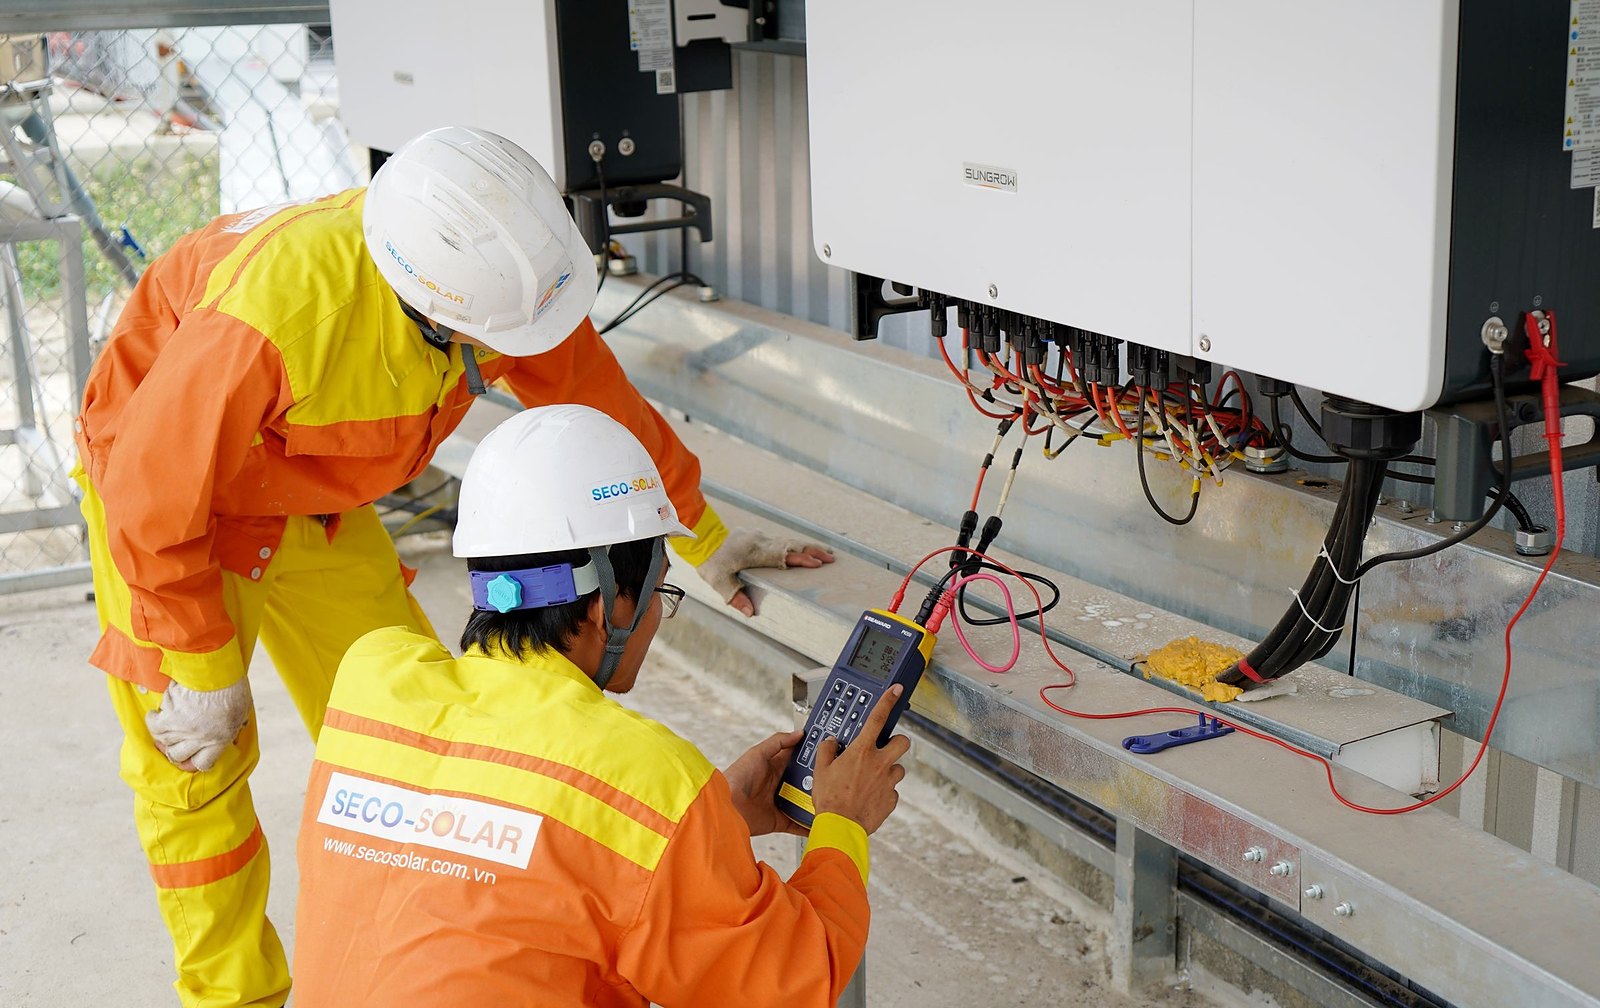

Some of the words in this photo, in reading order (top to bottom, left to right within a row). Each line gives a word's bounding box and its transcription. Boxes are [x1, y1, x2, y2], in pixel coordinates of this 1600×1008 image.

[965, 168, 1015, 187] SUNGROW
[385, 240, 465, 304] SECO-SOLAR
[331, 789, 523, 854] SECO-SOLAR
[323, 836, 497, 885] www.secosolar.com.vn
